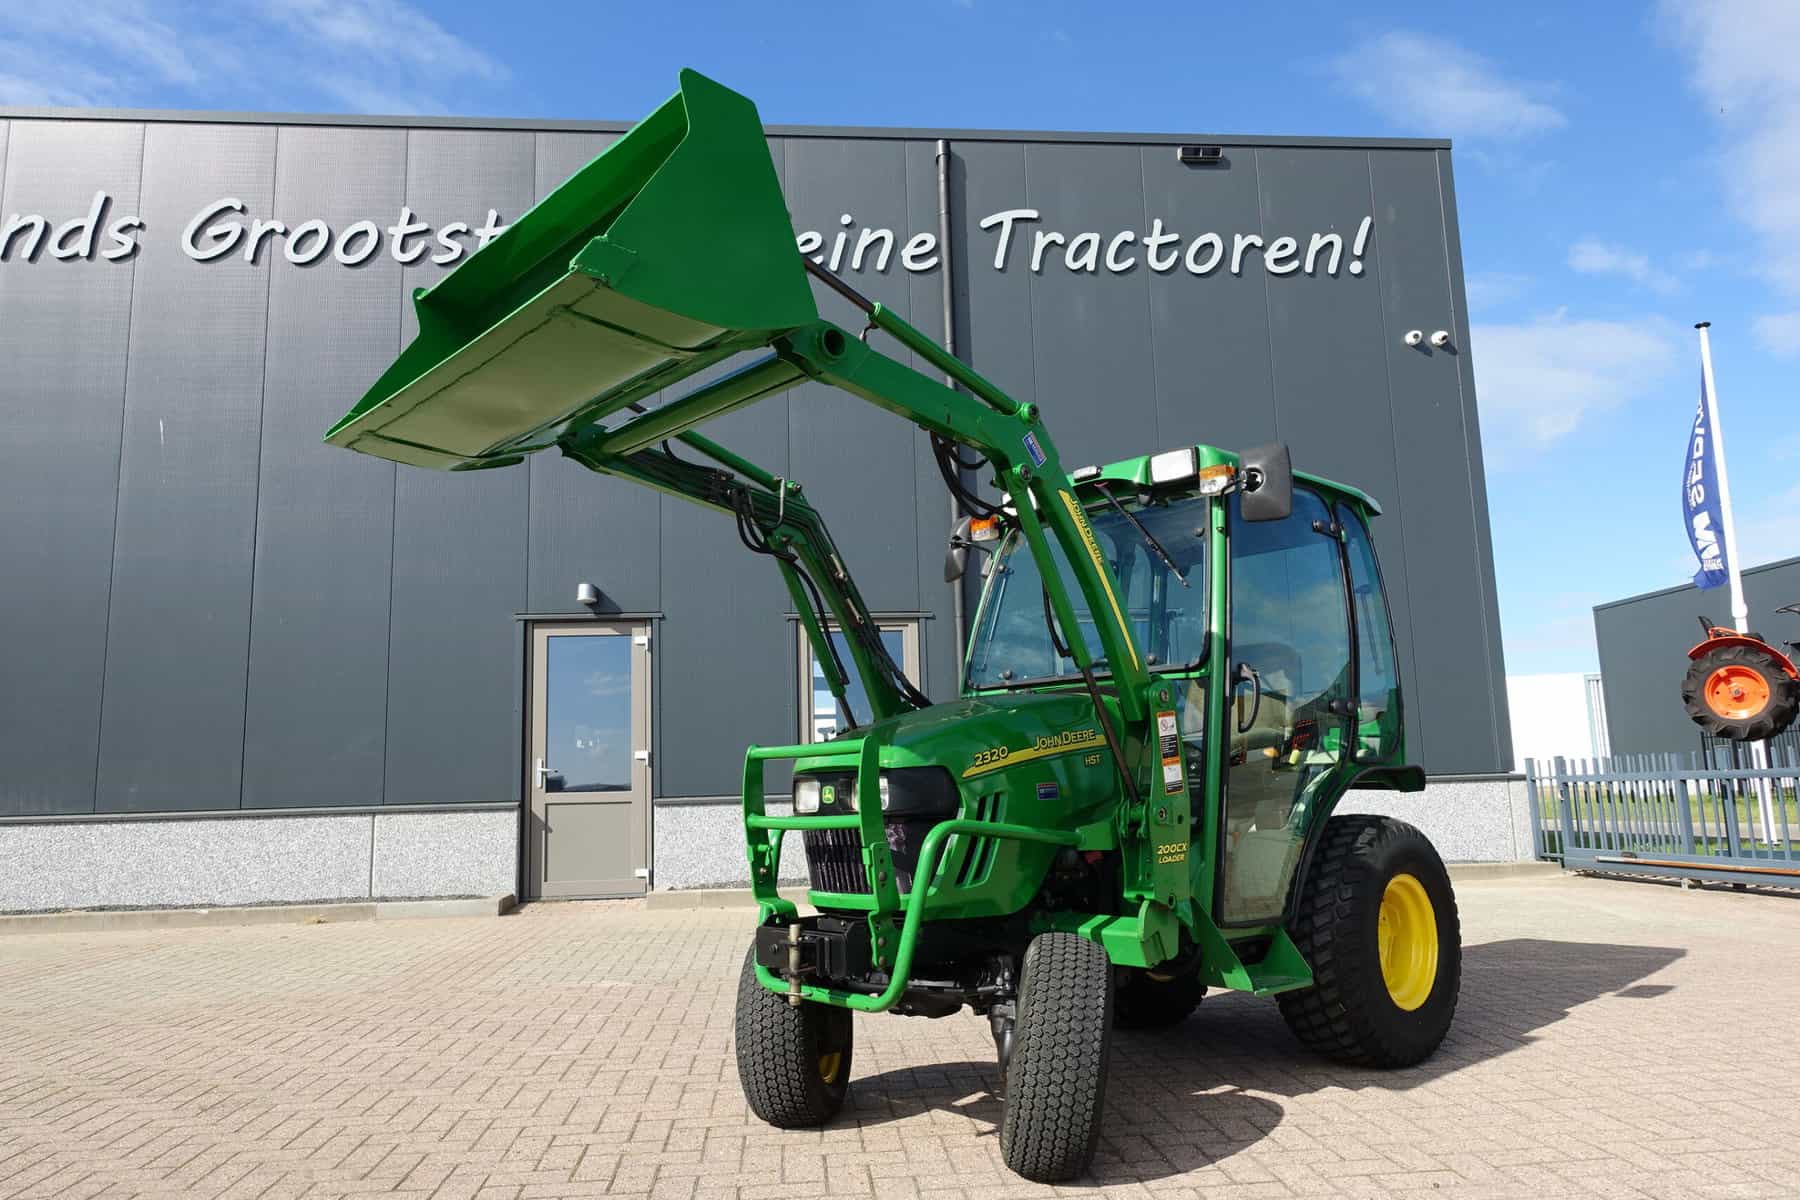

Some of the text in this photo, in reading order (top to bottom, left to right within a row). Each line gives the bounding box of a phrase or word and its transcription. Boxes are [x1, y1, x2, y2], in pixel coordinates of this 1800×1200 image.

[0, 190, 140, 259] nds
[980, 208, 1371, 275] Tractoren!
[1033, 729, 1096, 751] JOHN DEERE
[974, 746, 1008, 766] 2320
[1085, 755, 1101, 766] HST
[1158, 854, 1185, 864] LOADER
